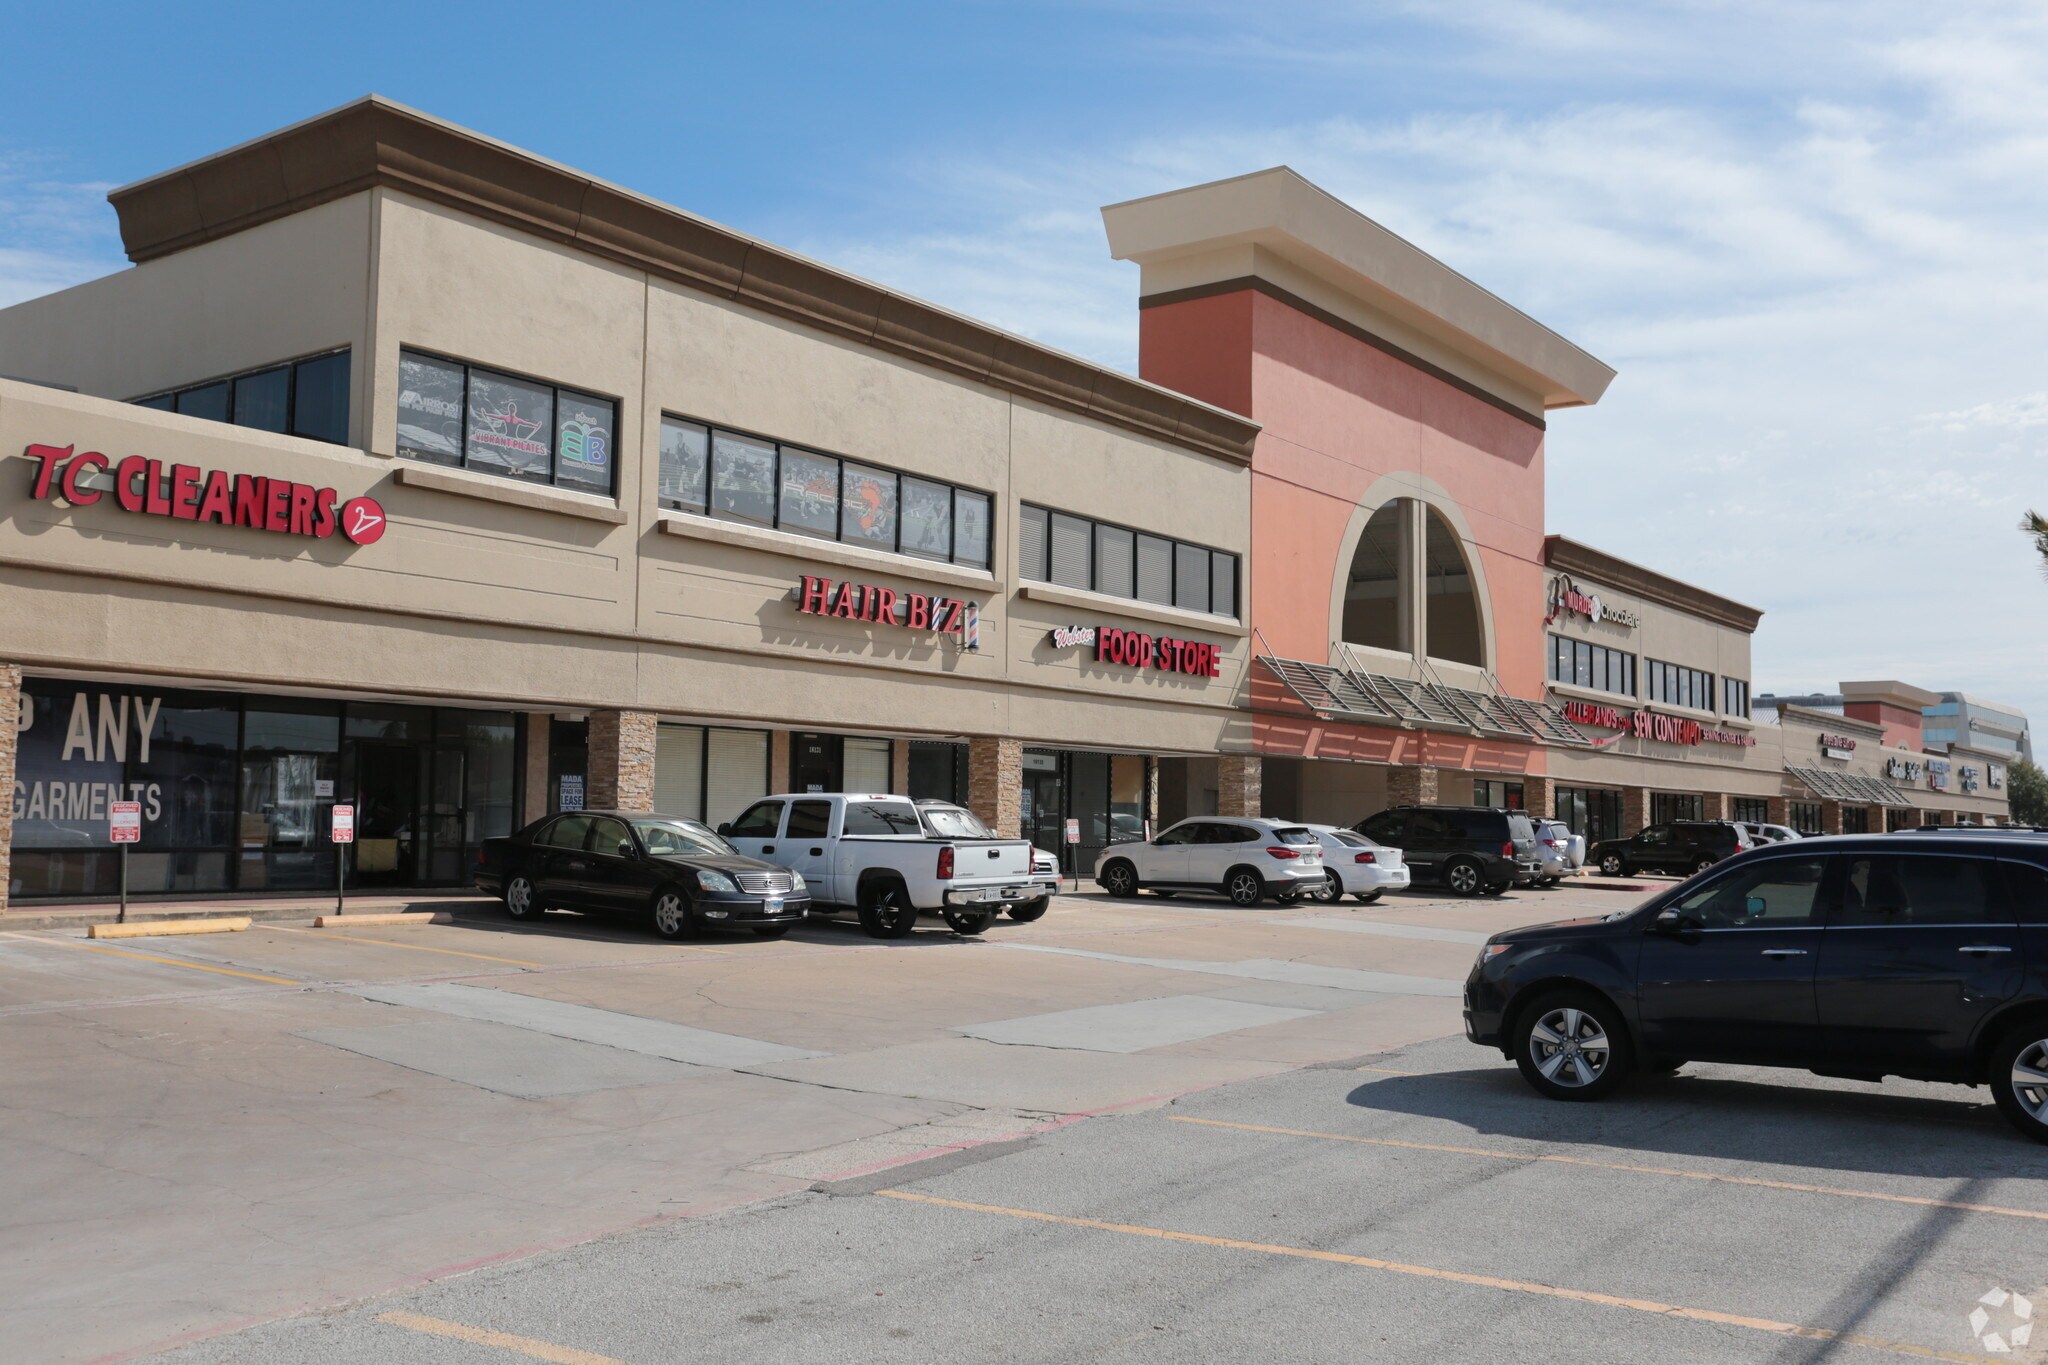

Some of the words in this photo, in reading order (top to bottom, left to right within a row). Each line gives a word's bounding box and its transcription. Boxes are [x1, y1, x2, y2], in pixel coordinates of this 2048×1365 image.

[475, 432, 511, 447] VIBRANT
[512, 438, 545, 454] PILATES
[24, 443, 109, 506] TC
[114, 455, 338, 538] CLEANERS
[799, 575, 899, 626] HAIR
[904, 593, 965, 634] BIZ
[1601, 604, 1640, 628] Chocolate
[1053, 625, 1095, 649] Webster
[1096, 626, 1153, 668] FOOD
[1157, 636, 1221, 678] STORE
[61, 692, 162, 763] ANY
[1632, 710, 1653, 739] SEW
[1654, 714, 1701, 746] CONTEMPO
[1702, 728, 1720, 742] SEWING
[1720, 731, 1737, 744] CENTER
[561, 775, 582, 783] MADA
[561, 796, 582, 806] LEASE
